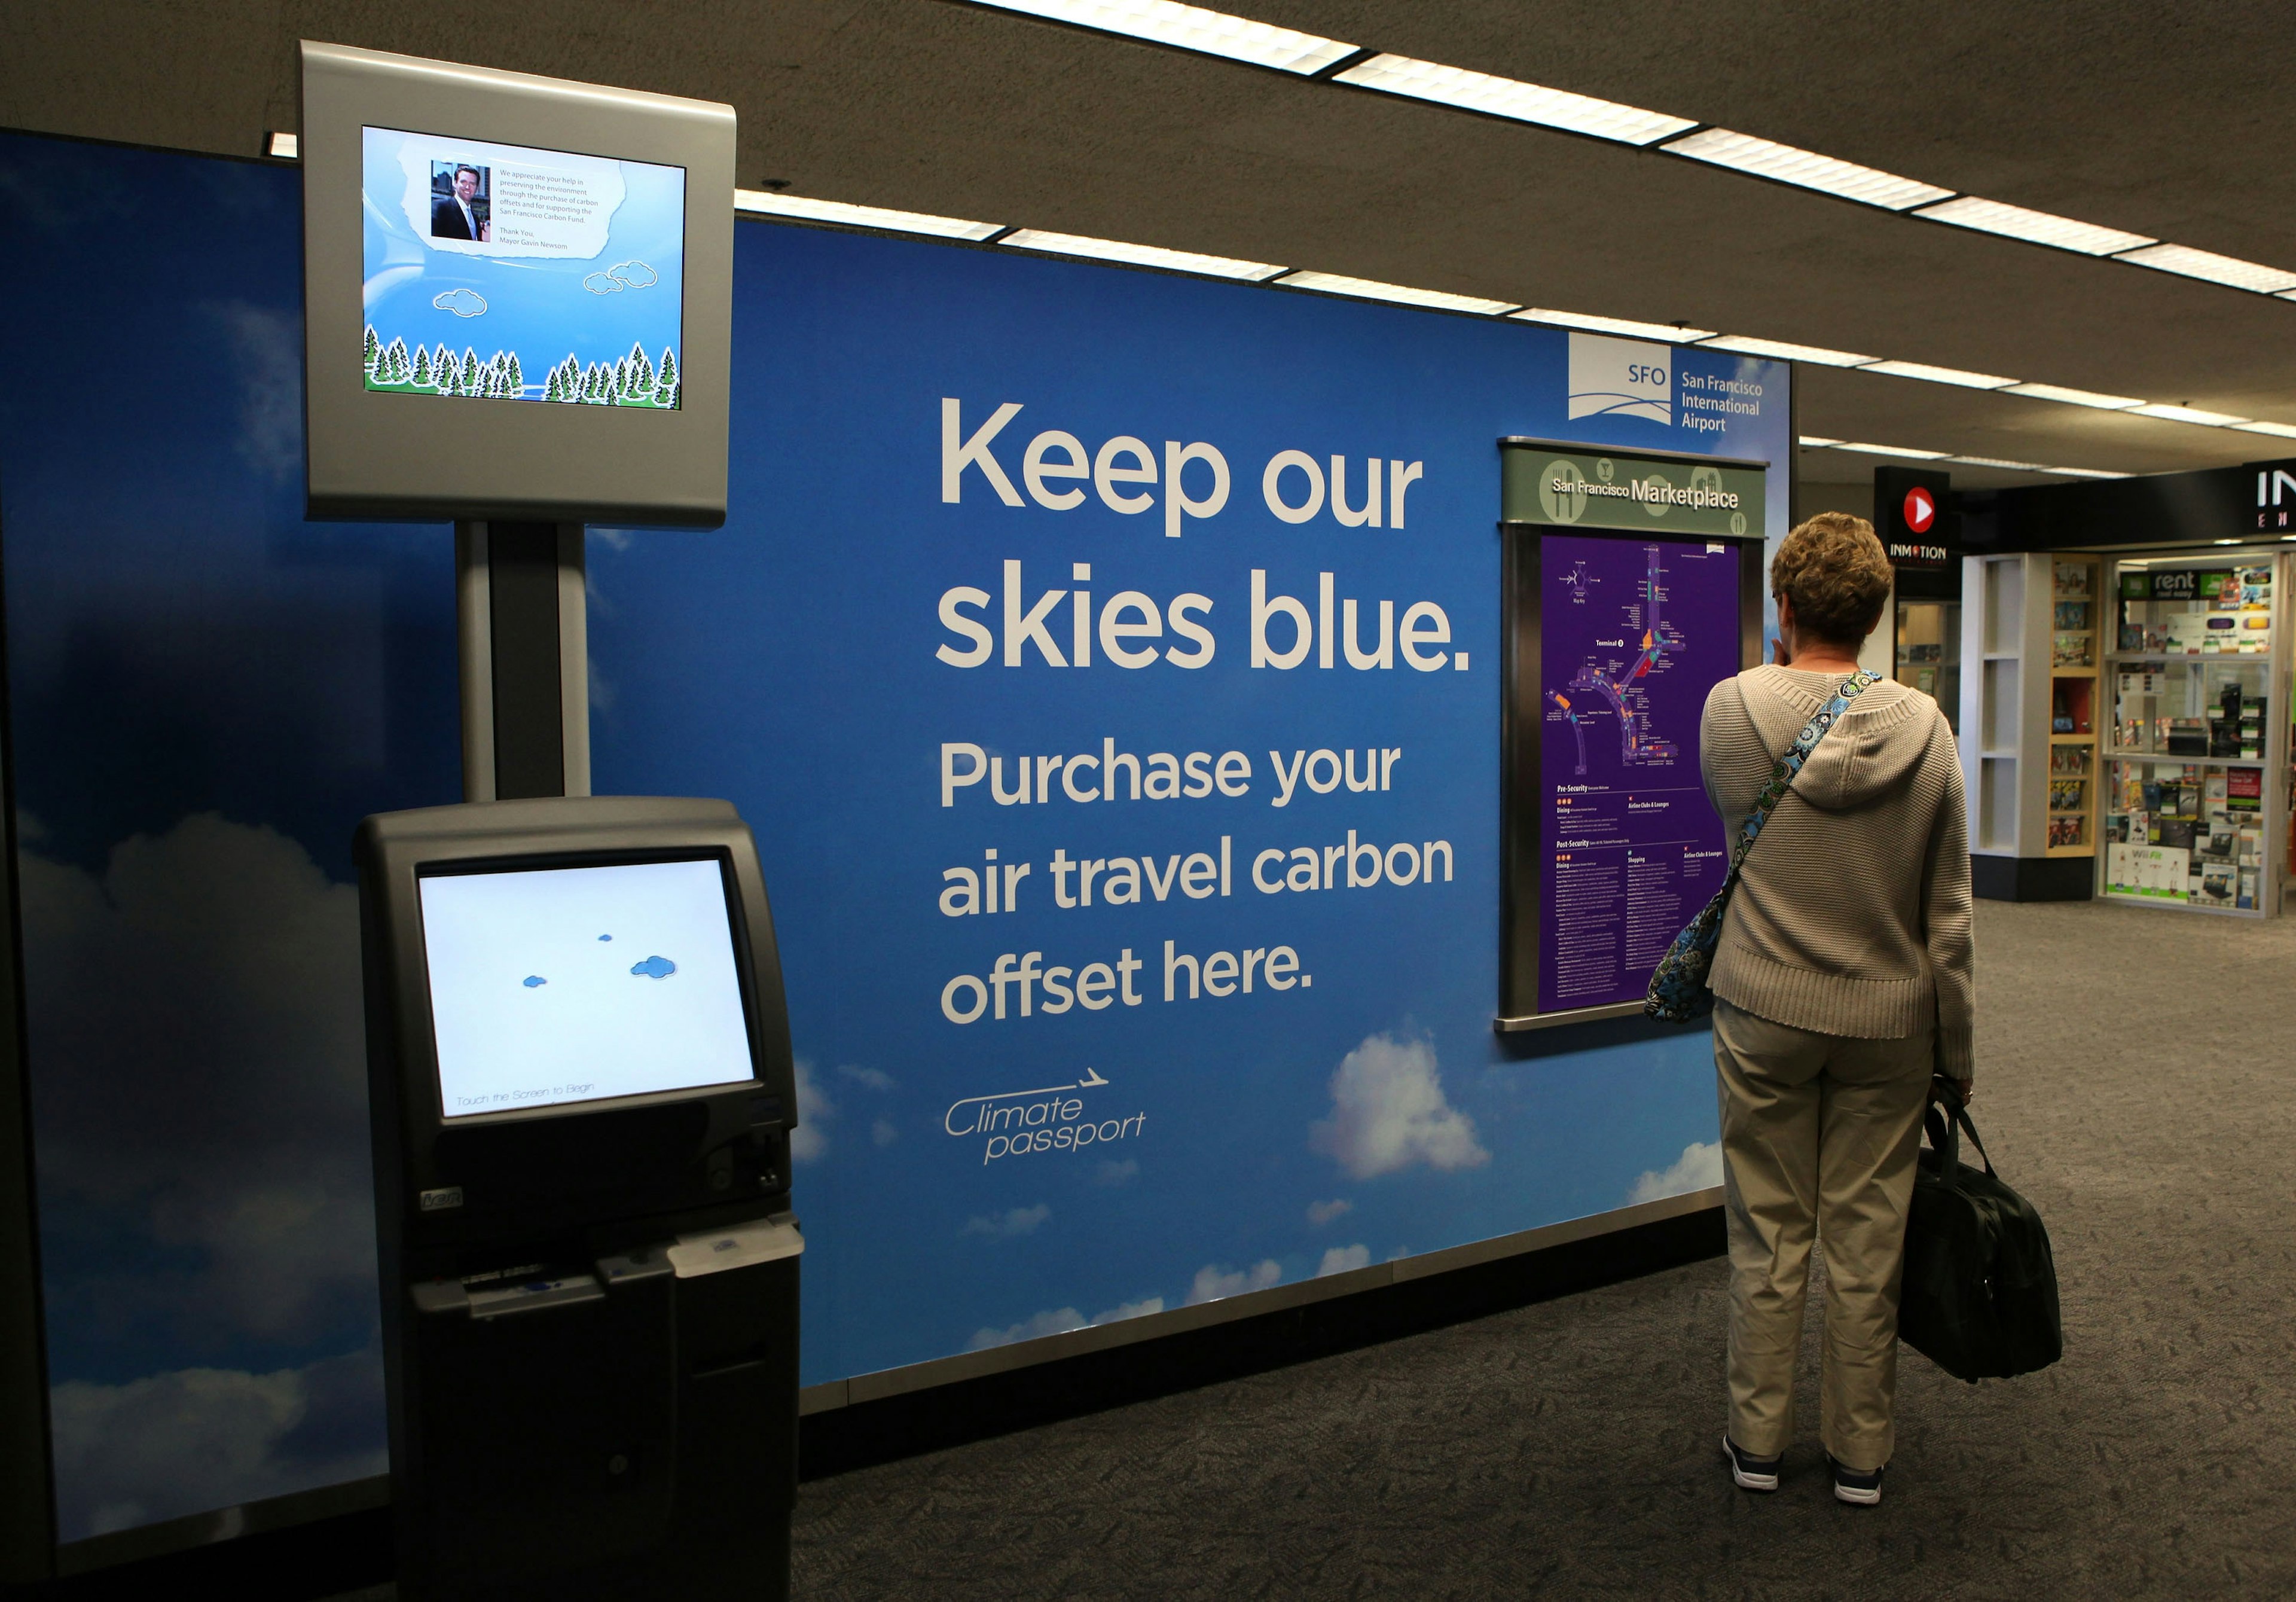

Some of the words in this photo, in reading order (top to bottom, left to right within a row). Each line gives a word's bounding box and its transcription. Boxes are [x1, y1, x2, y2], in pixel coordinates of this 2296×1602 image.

[512, 172, 545, 181] appreciate
[500, 181, 533, 190] preserving
[547, 187, 587, 196] environment
[500, 190, 526, 199] through
[539, 195, 567, 203] purchase
[544, 213, 566, 221] Carbon
[546, 205, 580, 215] supporting
[1629, 365, 1666, 385] SFO
[1682, 372, 1704, 389] San
[1708, 375, 1763, 396] Francisco
[1682, 392, 1760, 416] International
[1681, 413, 1726, 433] Airport
[942, 397, 1231, 538] Keep
[1262, 449, 1423, 530] our
[1552, 478, 1574, 493] San
[1577, 480, 1629, 498] Francisco
[1631, 480, 1738, 510] Marketplace
[2155, 571, 2195, 590] rent
[935, 559, 1216, 669] skies
[1250, 569, 1469, 672] blue.
[941, 737, 1252, 807] Purchase
[1269, 747, 1401, 808] your
[1558, 784, 1587, 792] Pre-Security
[1556, 840, 1589, 848] Post-Security
[939, 848, 1030, 917] air
[1049, 835, 1231, 909] travel
[1252, 829, 1453, 894] carbon
[941, 948, 1143, 1024] offset
[1164, 939, 1312, 1002] here.
[457, 1095, 489, 1106] Touch
[493, 1093, 509, 1101] the
[512, 1088, 549, 1100] Screen
[554, 1086, 563, 1095] to
[566, 1083, 594, 1094] Begin
[945, 1085, 1083, 1136] Climate
[984, 1112, 1146, 1165] passport
